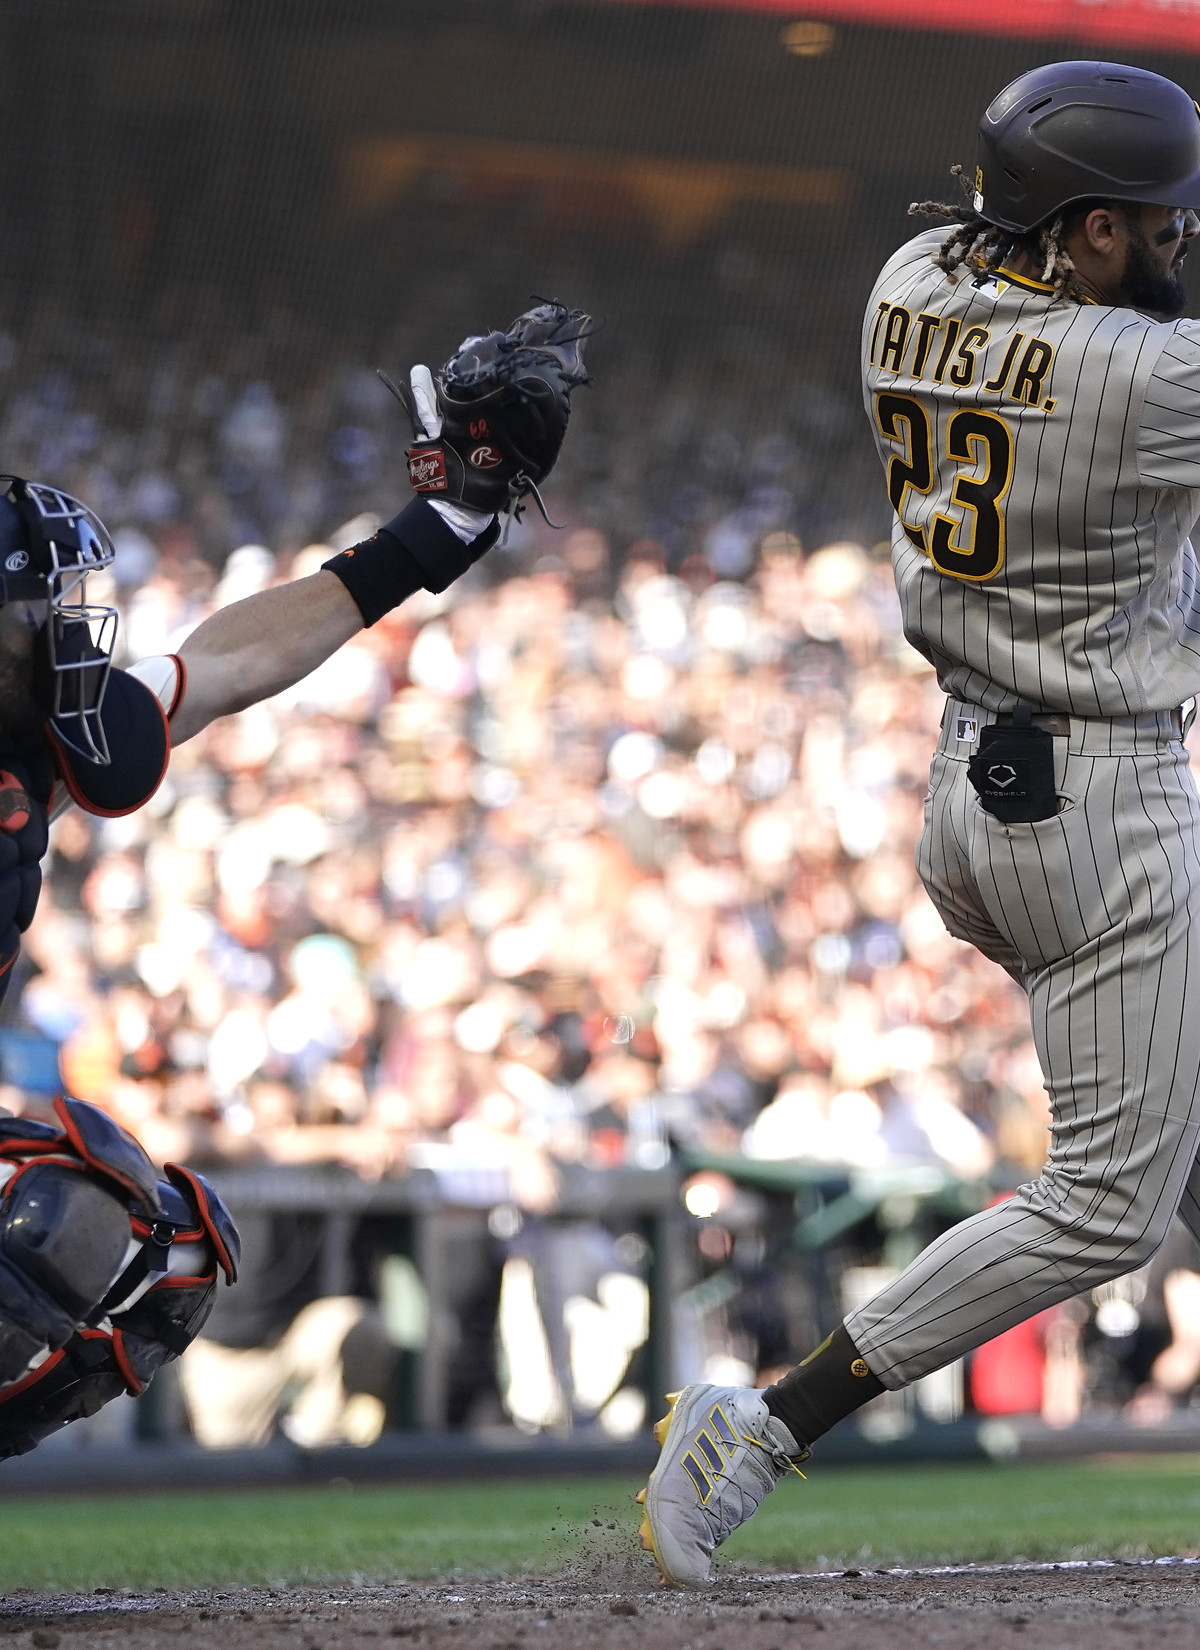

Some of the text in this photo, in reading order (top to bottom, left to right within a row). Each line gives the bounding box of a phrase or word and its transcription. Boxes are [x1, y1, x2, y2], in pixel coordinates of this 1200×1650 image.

[870, 302, 1057, 413] TATIS JR.
[875, 392, 1013, 581] 23
